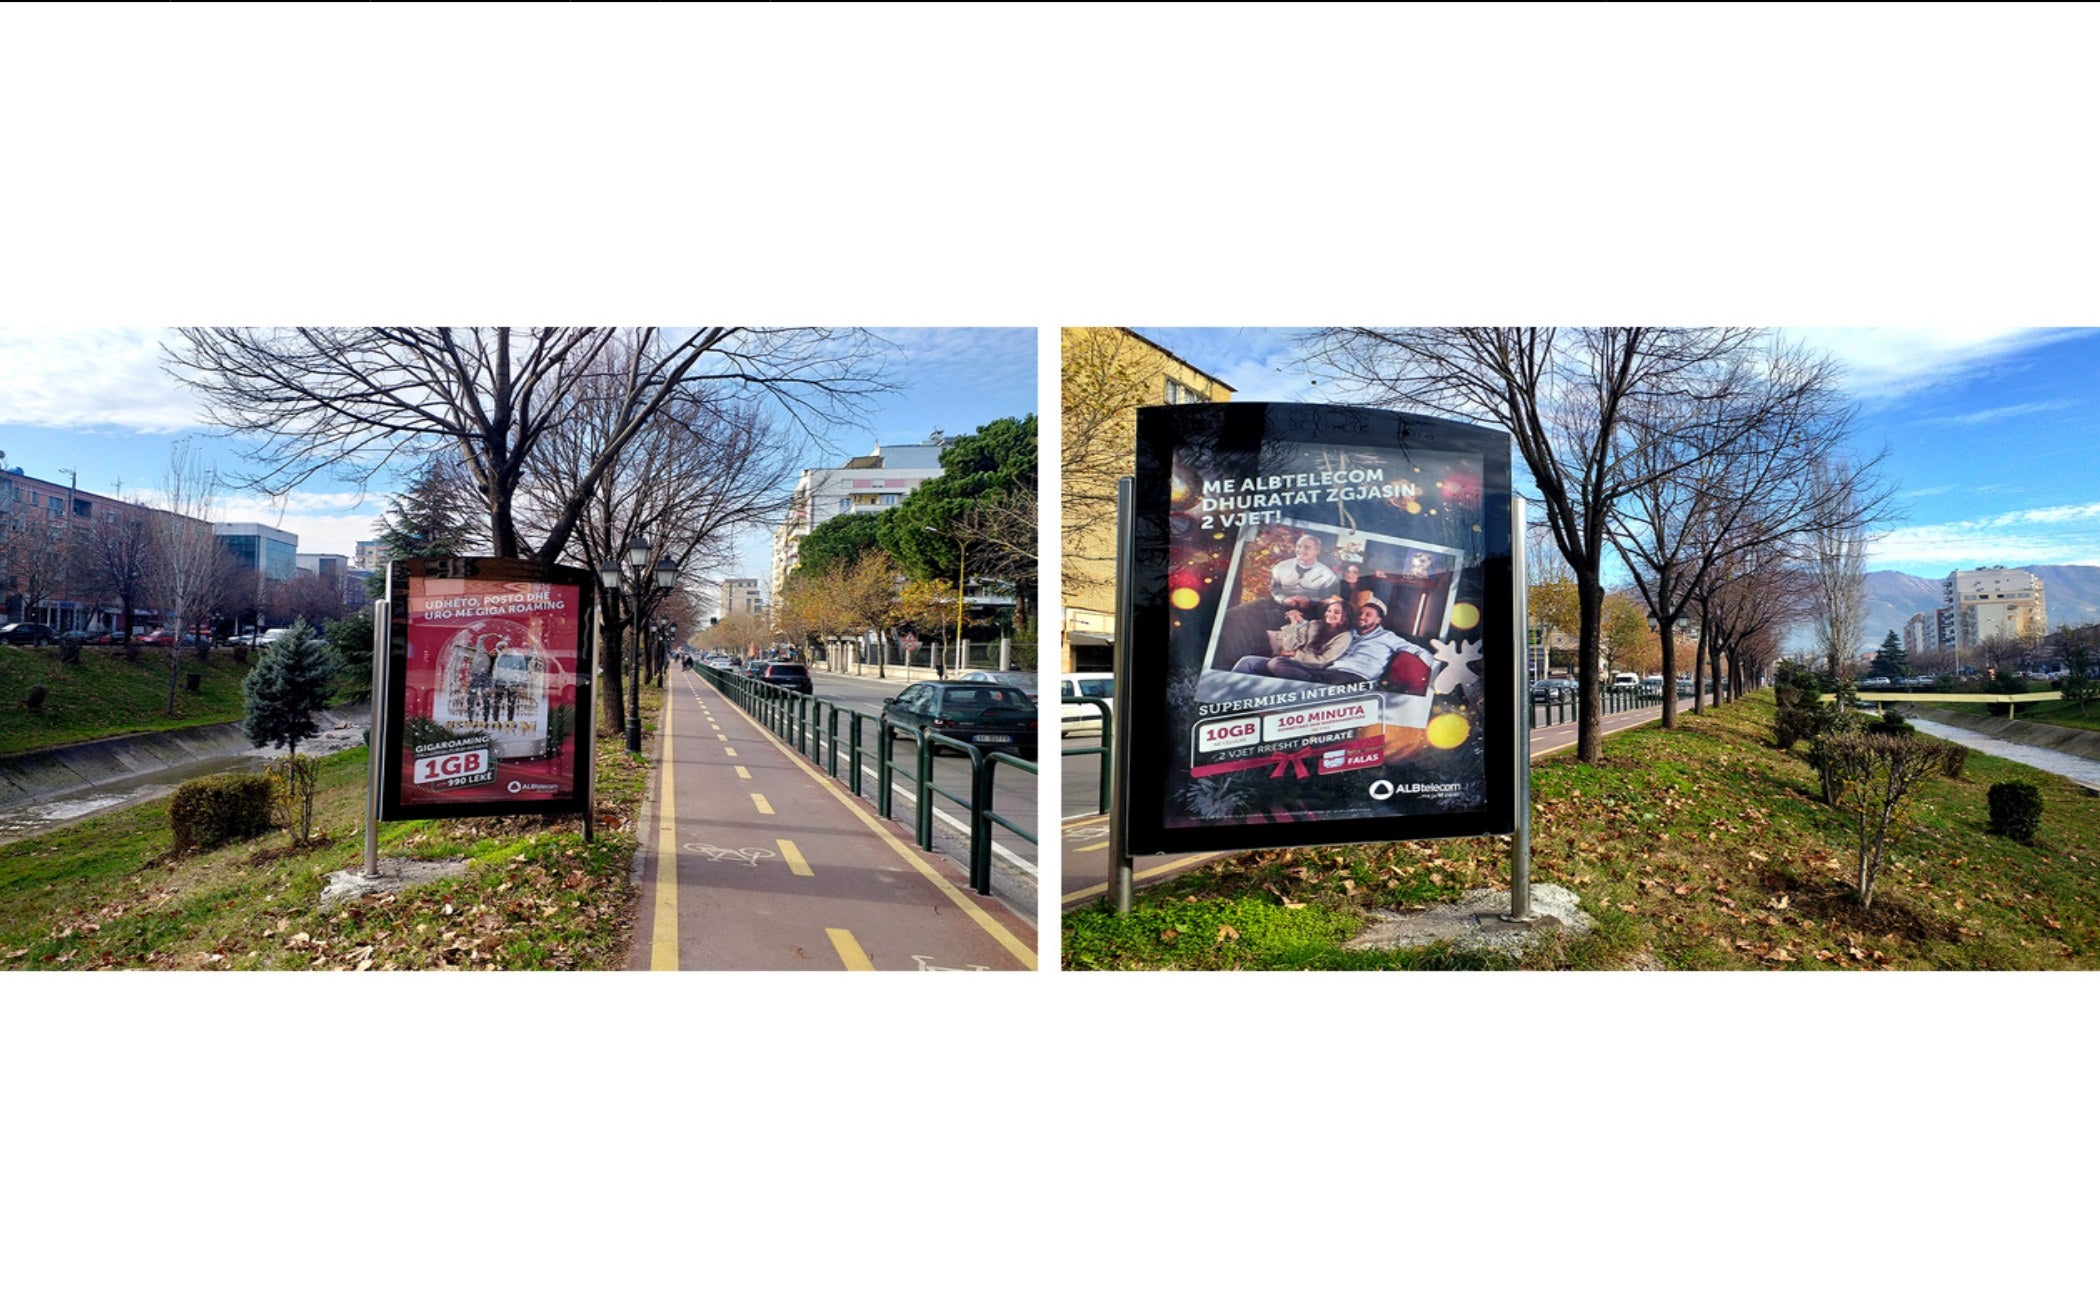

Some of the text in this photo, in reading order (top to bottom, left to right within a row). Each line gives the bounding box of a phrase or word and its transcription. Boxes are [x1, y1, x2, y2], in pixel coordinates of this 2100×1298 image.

[1202, 468, 1384, 494] ME ALBTELECOM
[1202, 484, 1416, 512] DHURATAT ZGJASIN
[1201, 510, 1281, 530] 2 VJET!
[484, 594, 525, 605] POSTO
[527, 591, 550, 602] DHE
[425, 601, 565, 620] URO ME GIGA ROAMING
[1199, 681, 1375, 716] SUPERMIKS INTERNET
[1277, 715, 1304, 727] 100
[1308, 705, 1366, 722] MINUTA
[1206, 723, 1256, 741] 10GB
[415, 736, 490, 753] GIGAROAMING
[1218, 752, 1226, 760] 2
[1229, 746, 1255, 758] VJET
[1257, 740, 1299, 753] RRESHT
[424, 753, 481, 779] 1GB
[1347, 753, 1380, 765] FALAS
[447, 777, 466, 787] 990
[1395, 782, 1462, 793] ALBtelecom
